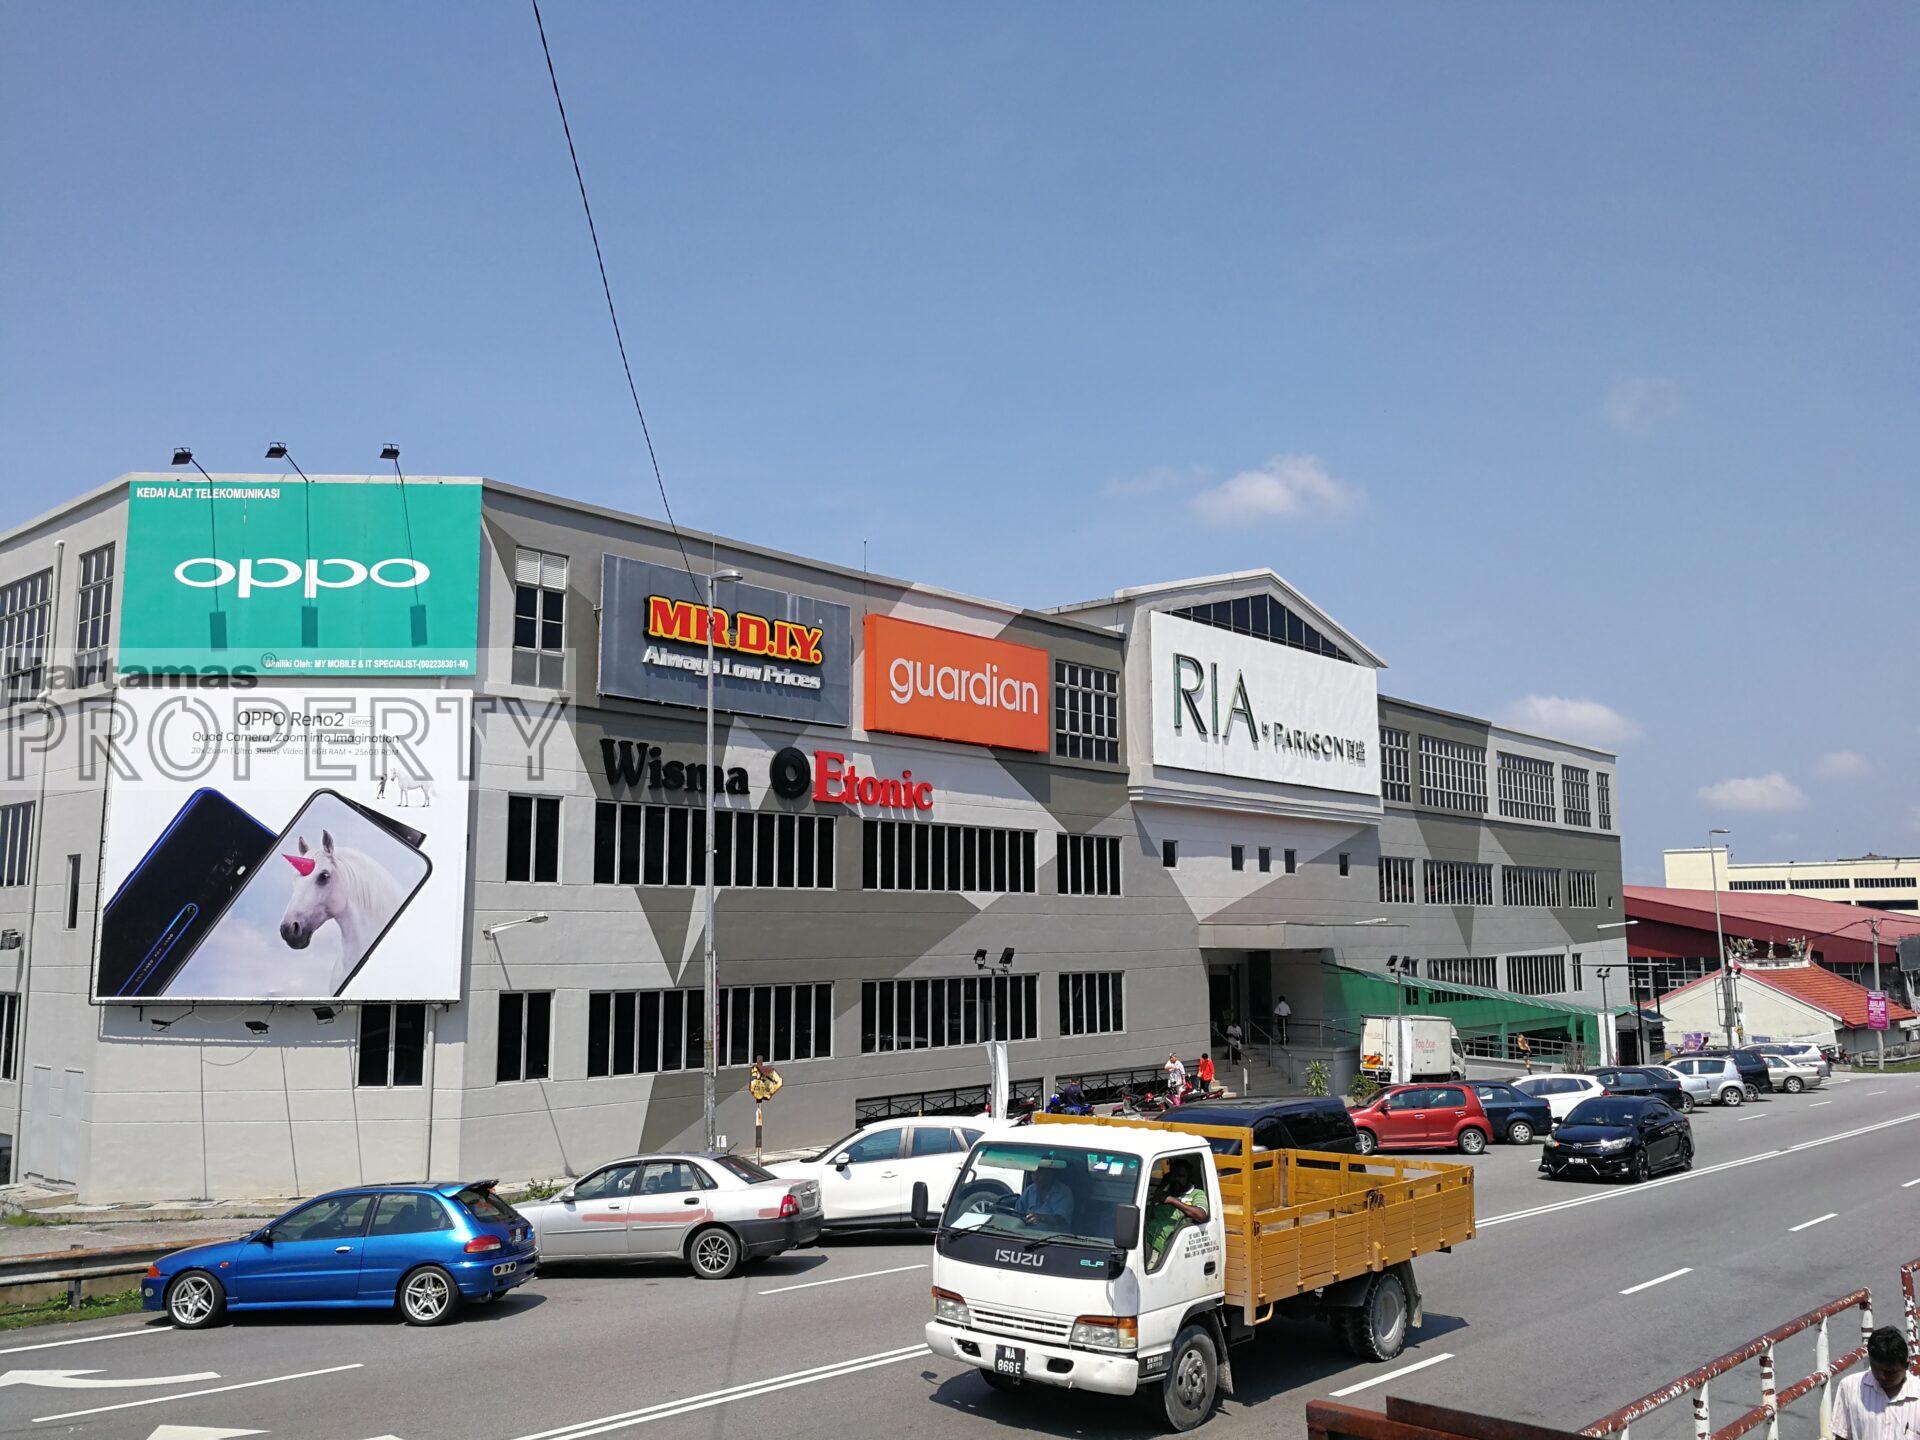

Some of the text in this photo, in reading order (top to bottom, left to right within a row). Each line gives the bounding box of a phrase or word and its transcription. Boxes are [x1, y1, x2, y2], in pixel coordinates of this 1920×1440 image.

[136, 487, 280, 499] KEDAI ALAT TELEKOMUNIKASI
[314, 659, 327, 669] MY
[328, 659, 356, 669] MOBILE
[357, 659, 364, 669] &
[365, 659, 373, 669] IT
[642, 645, 821, 690] Always Low Prices
[889, 657, 1039, 715] guardian
[1173, 652, 1260, 743] RIA
[237, 710, 286, 726] OPPO
[290, 711, 344, 727] Reno2
[192, 731, 400, 746] Quad Camera, Zoom into Imagination
[282, 747, 304, 756] Video
[329, 748, 346, 756] RAM
[600, 738, 750, 795] Wisma
[812, 749, 934, 810] Etonic
[994, 1248, 1045, 1267] ISUZU
